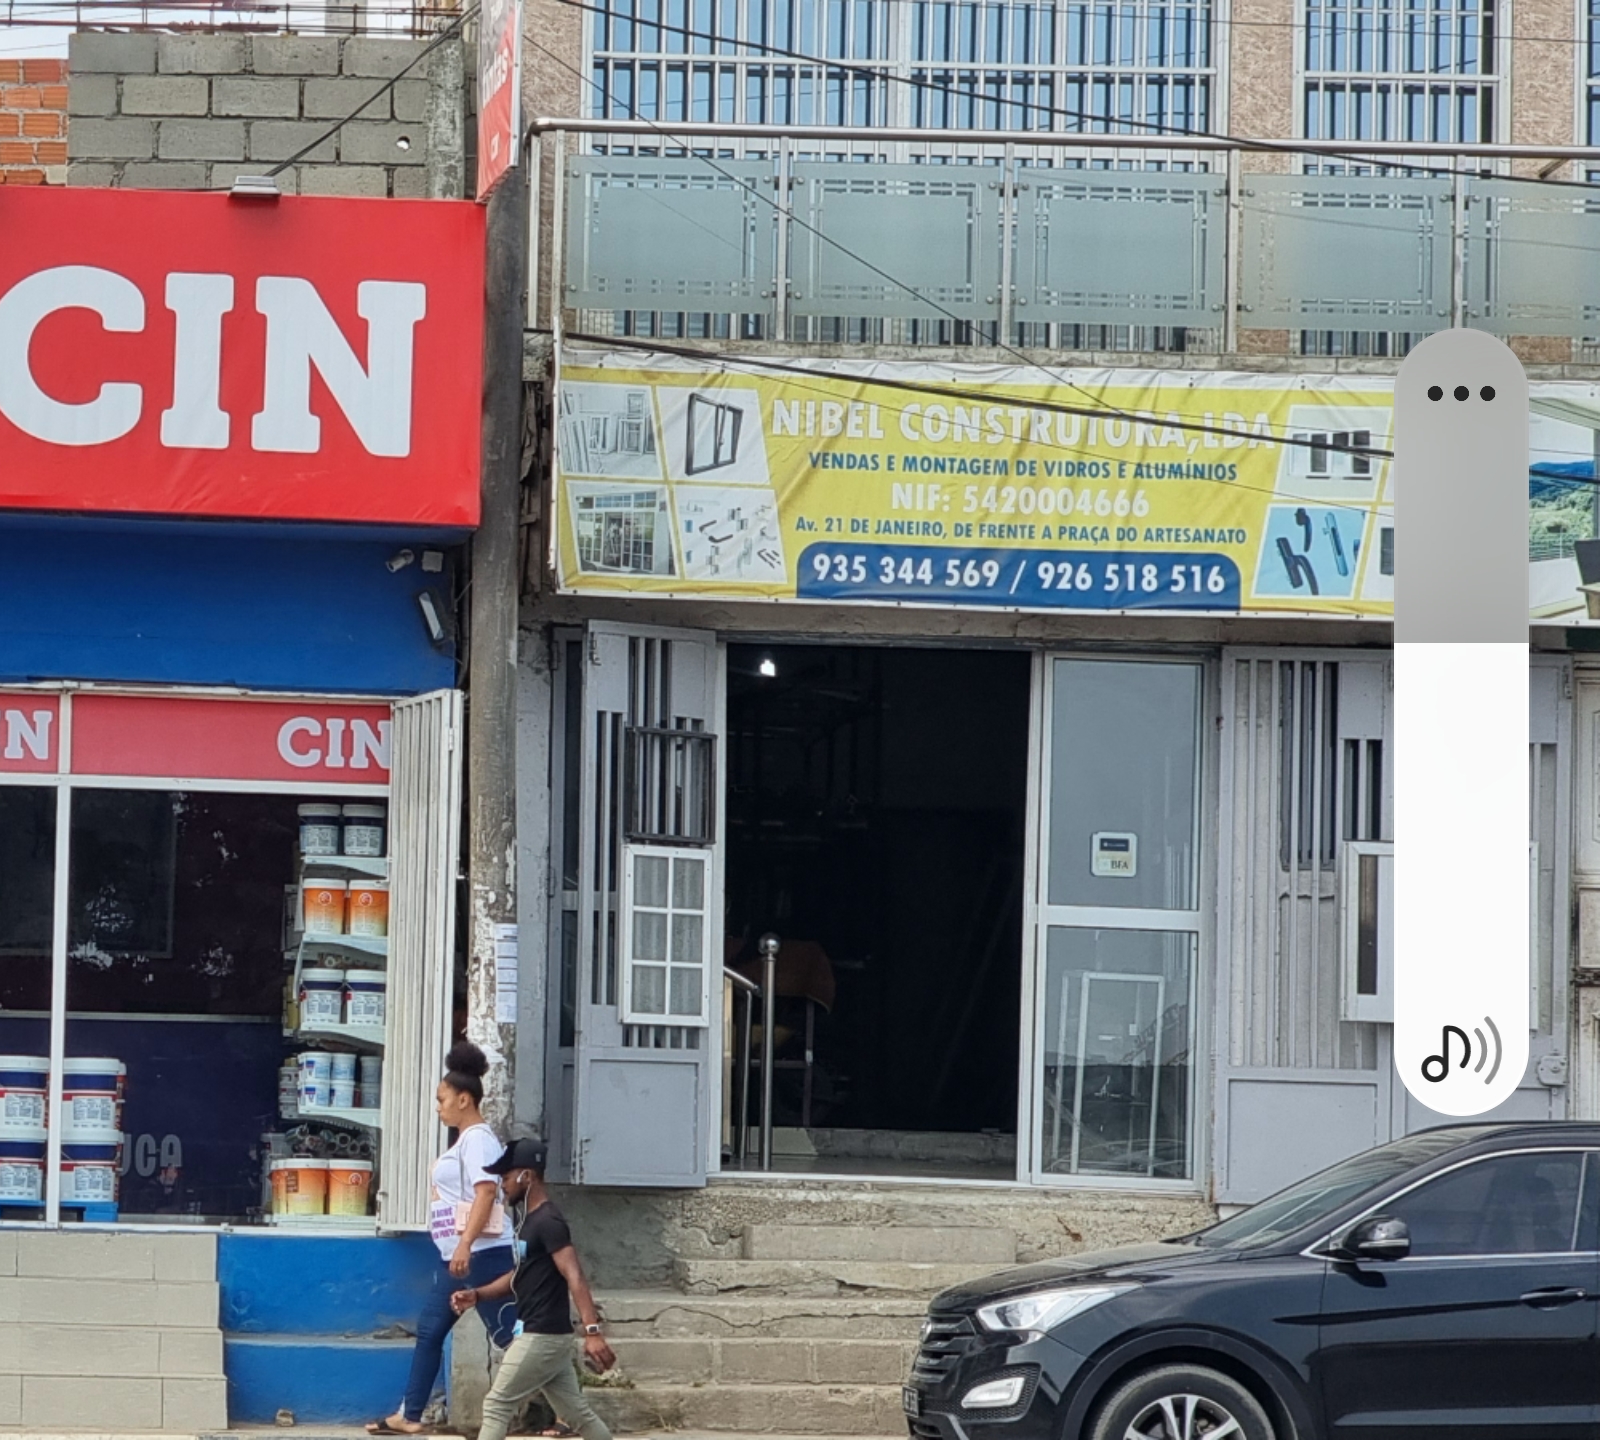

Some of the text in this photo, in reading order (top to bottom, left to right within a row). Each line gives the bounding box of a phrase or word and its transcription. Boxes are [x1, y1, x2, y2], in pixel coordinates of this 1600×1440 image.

[772, 399, 885, 439] NIBEL
[809, 451, 1237, 481] VENDAS E MONTAGEM DE VIDROS E ALUMÍNIOS
[891, 482, 1150, 517] NIF: 5420004666
[795, 516, 1247, 545] Av. 21 DE JANEIRO, DE FRENTE A PRAÇA DO ARTESANATO
[813, 553, 1226, 595] 935 344 569 / 926 518 516
[277, 716, 391, 770] CIN
